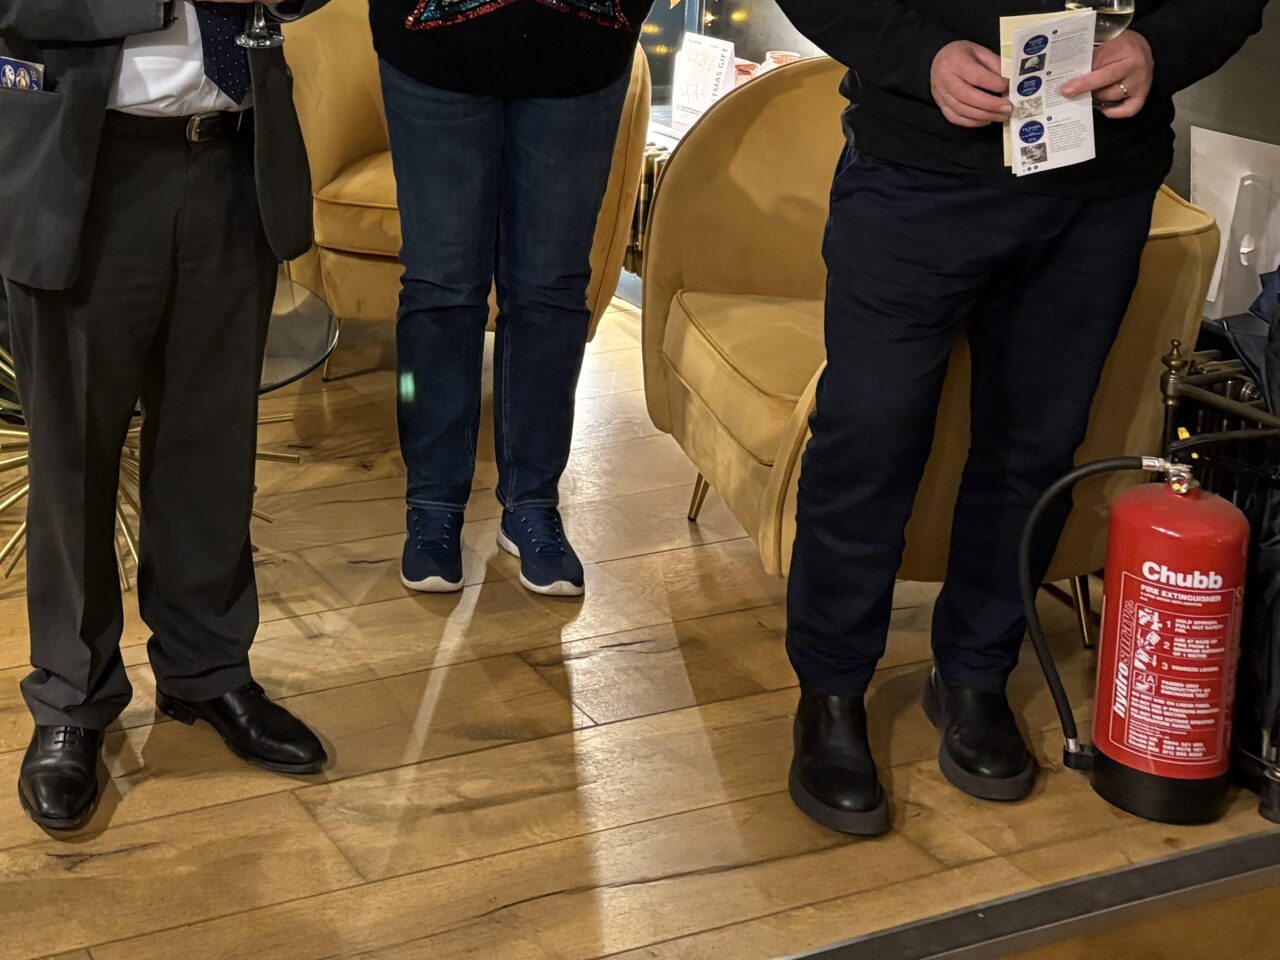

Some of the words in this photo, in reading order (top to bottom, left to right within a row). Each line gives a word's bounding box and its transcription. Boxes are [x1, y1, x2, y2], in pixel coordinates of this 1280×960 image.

[1142, 561, 1223, 589] Chubb
[1140, 584, 1159, 595] FIRE
[1161, 590, 1222, 602] EXTINGUISHER
